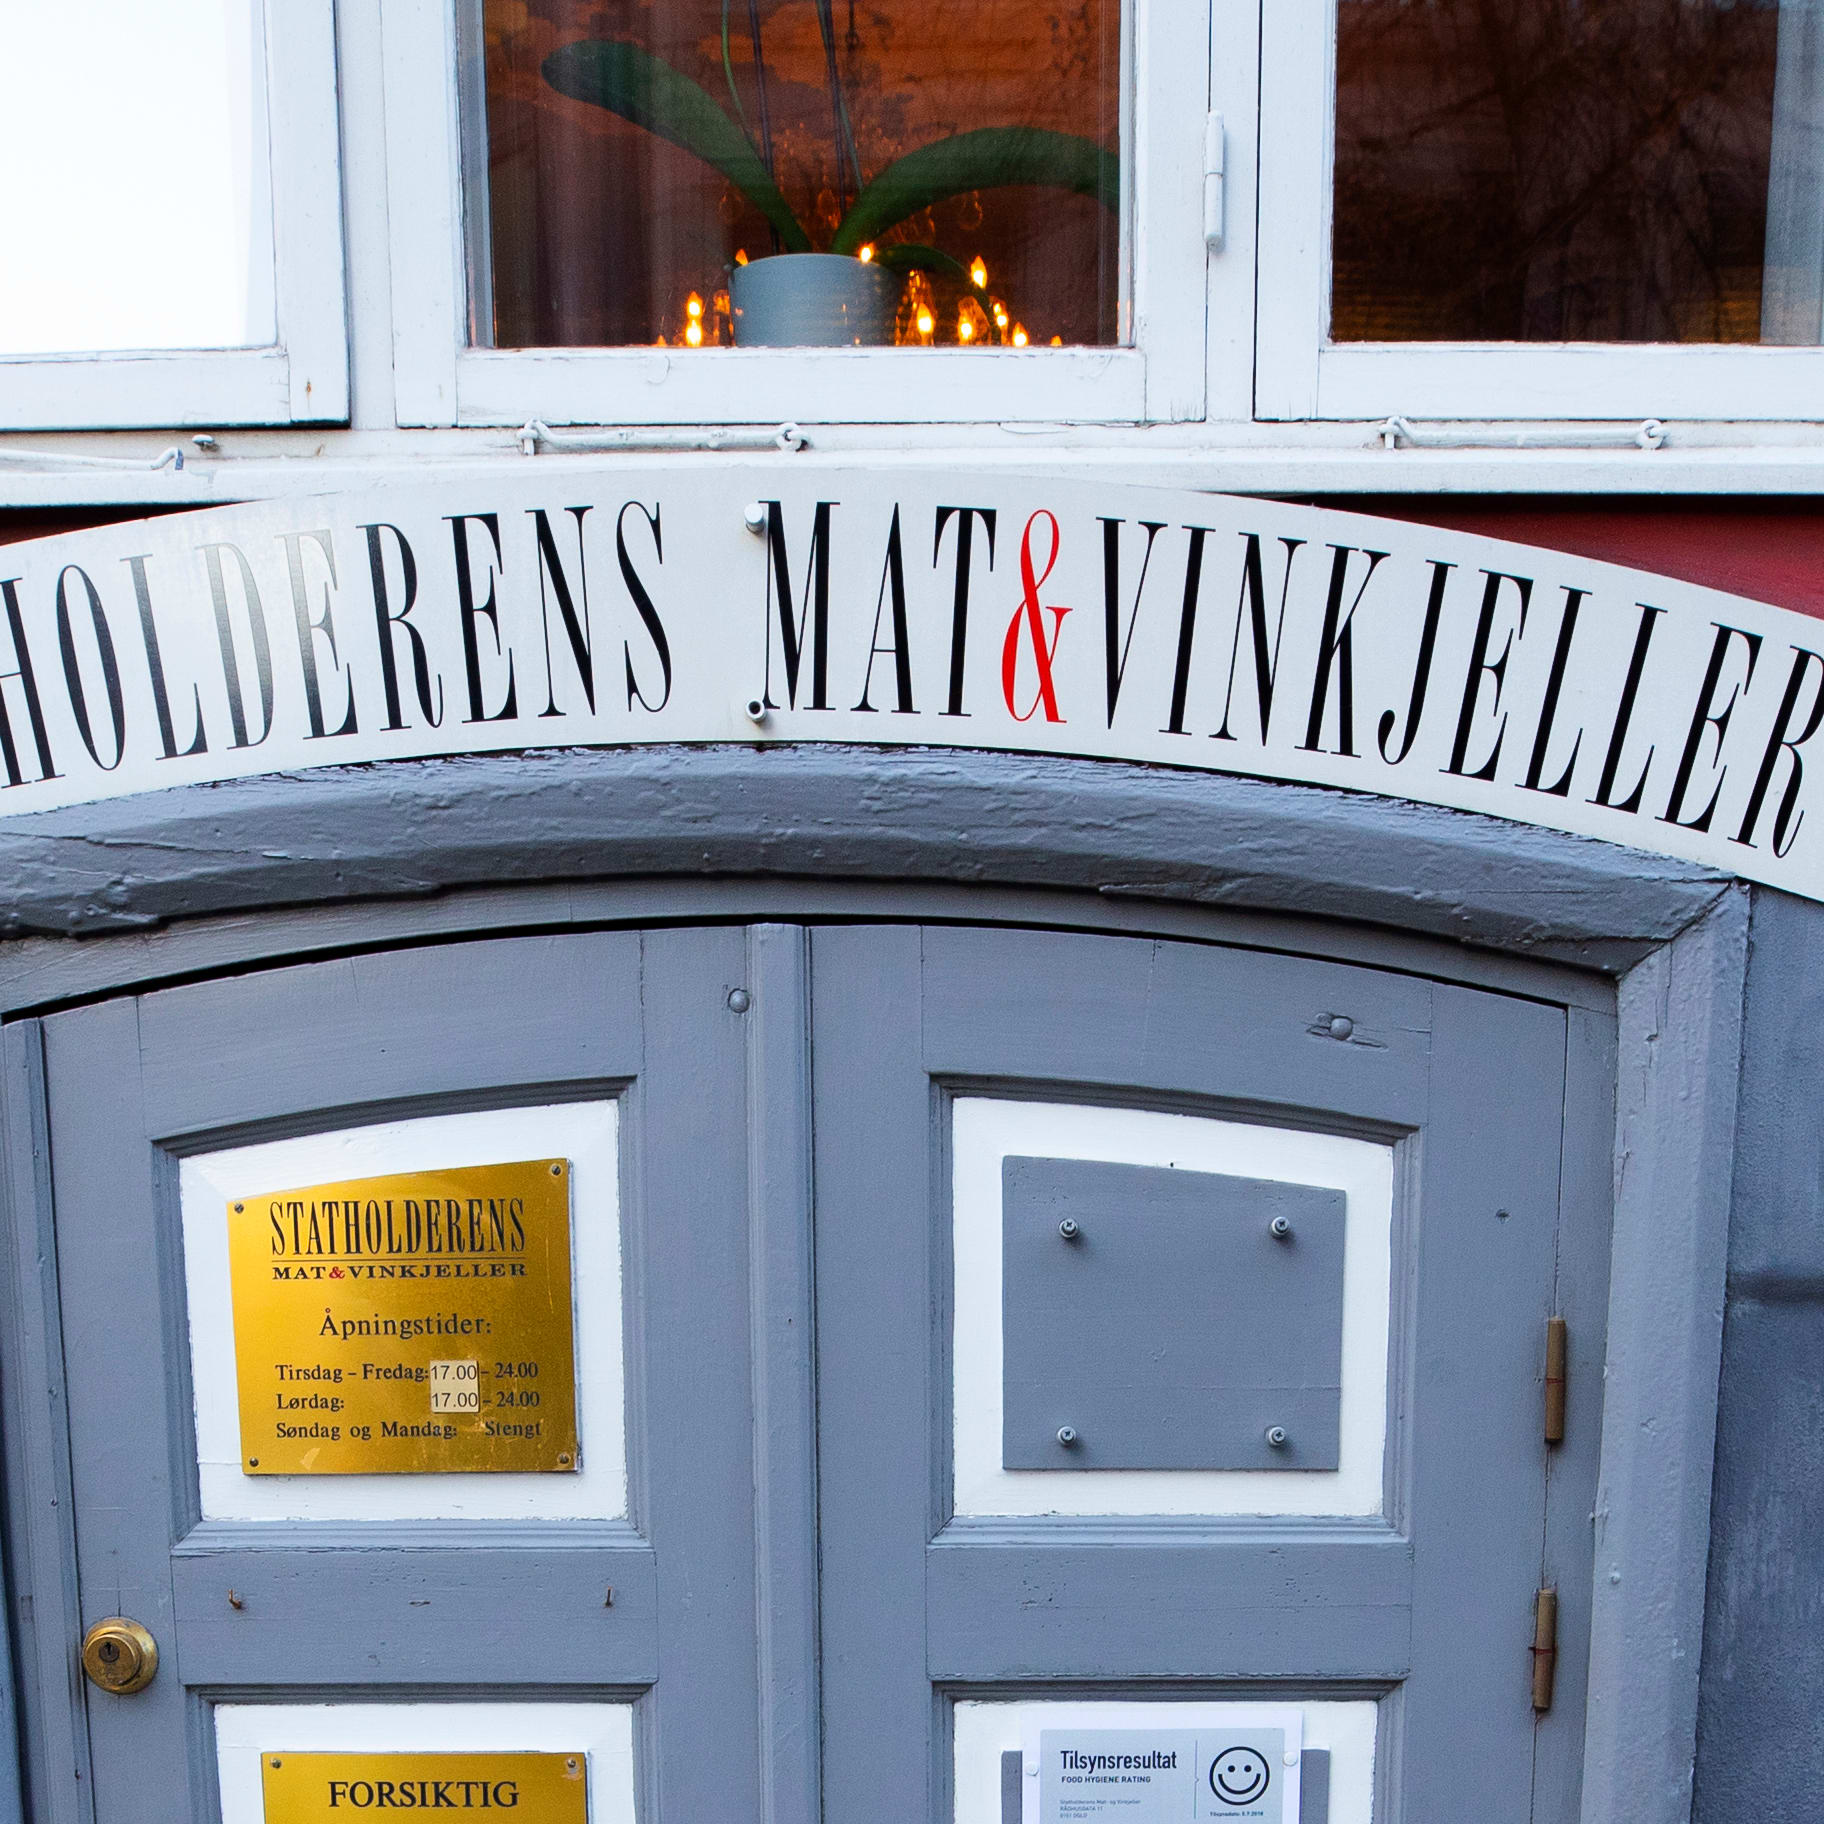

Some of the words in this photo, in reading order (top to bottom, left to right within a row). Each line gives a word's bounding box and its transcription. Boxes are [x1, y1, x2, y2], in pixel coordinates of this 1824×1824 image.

[269, 1197, 526, 1256] STATHOLDERENS
[271, 1263, 528, 1280] MAT&VINKJELLER
[319, 1307, 493, 1340] Åpningstider:
[274, 1364, 343, 1384] Tirsdag
[362, 1363, 429, 1384] Fredag:
[431, 1365, 477, 1381] 17.00
[494, 1362, 539, 1379] 24.00
[276, 1393, 345, 1413] Lørdag:
[432, 1392, 478, 1408] 17.00
[497, 1391, 540, 1408] 24.00
[276, 1422, 341, 1441] Søndag
[349, 1425, 372, 1440] og
[380, 1422, 458, 1440] Mandag:
[484, 1421, 542, 1439] Stengt
[1060, 1750, 1177, 1774] Tilsynsresultat
[328, 1781, 520, 1808] FORSIKTIG
